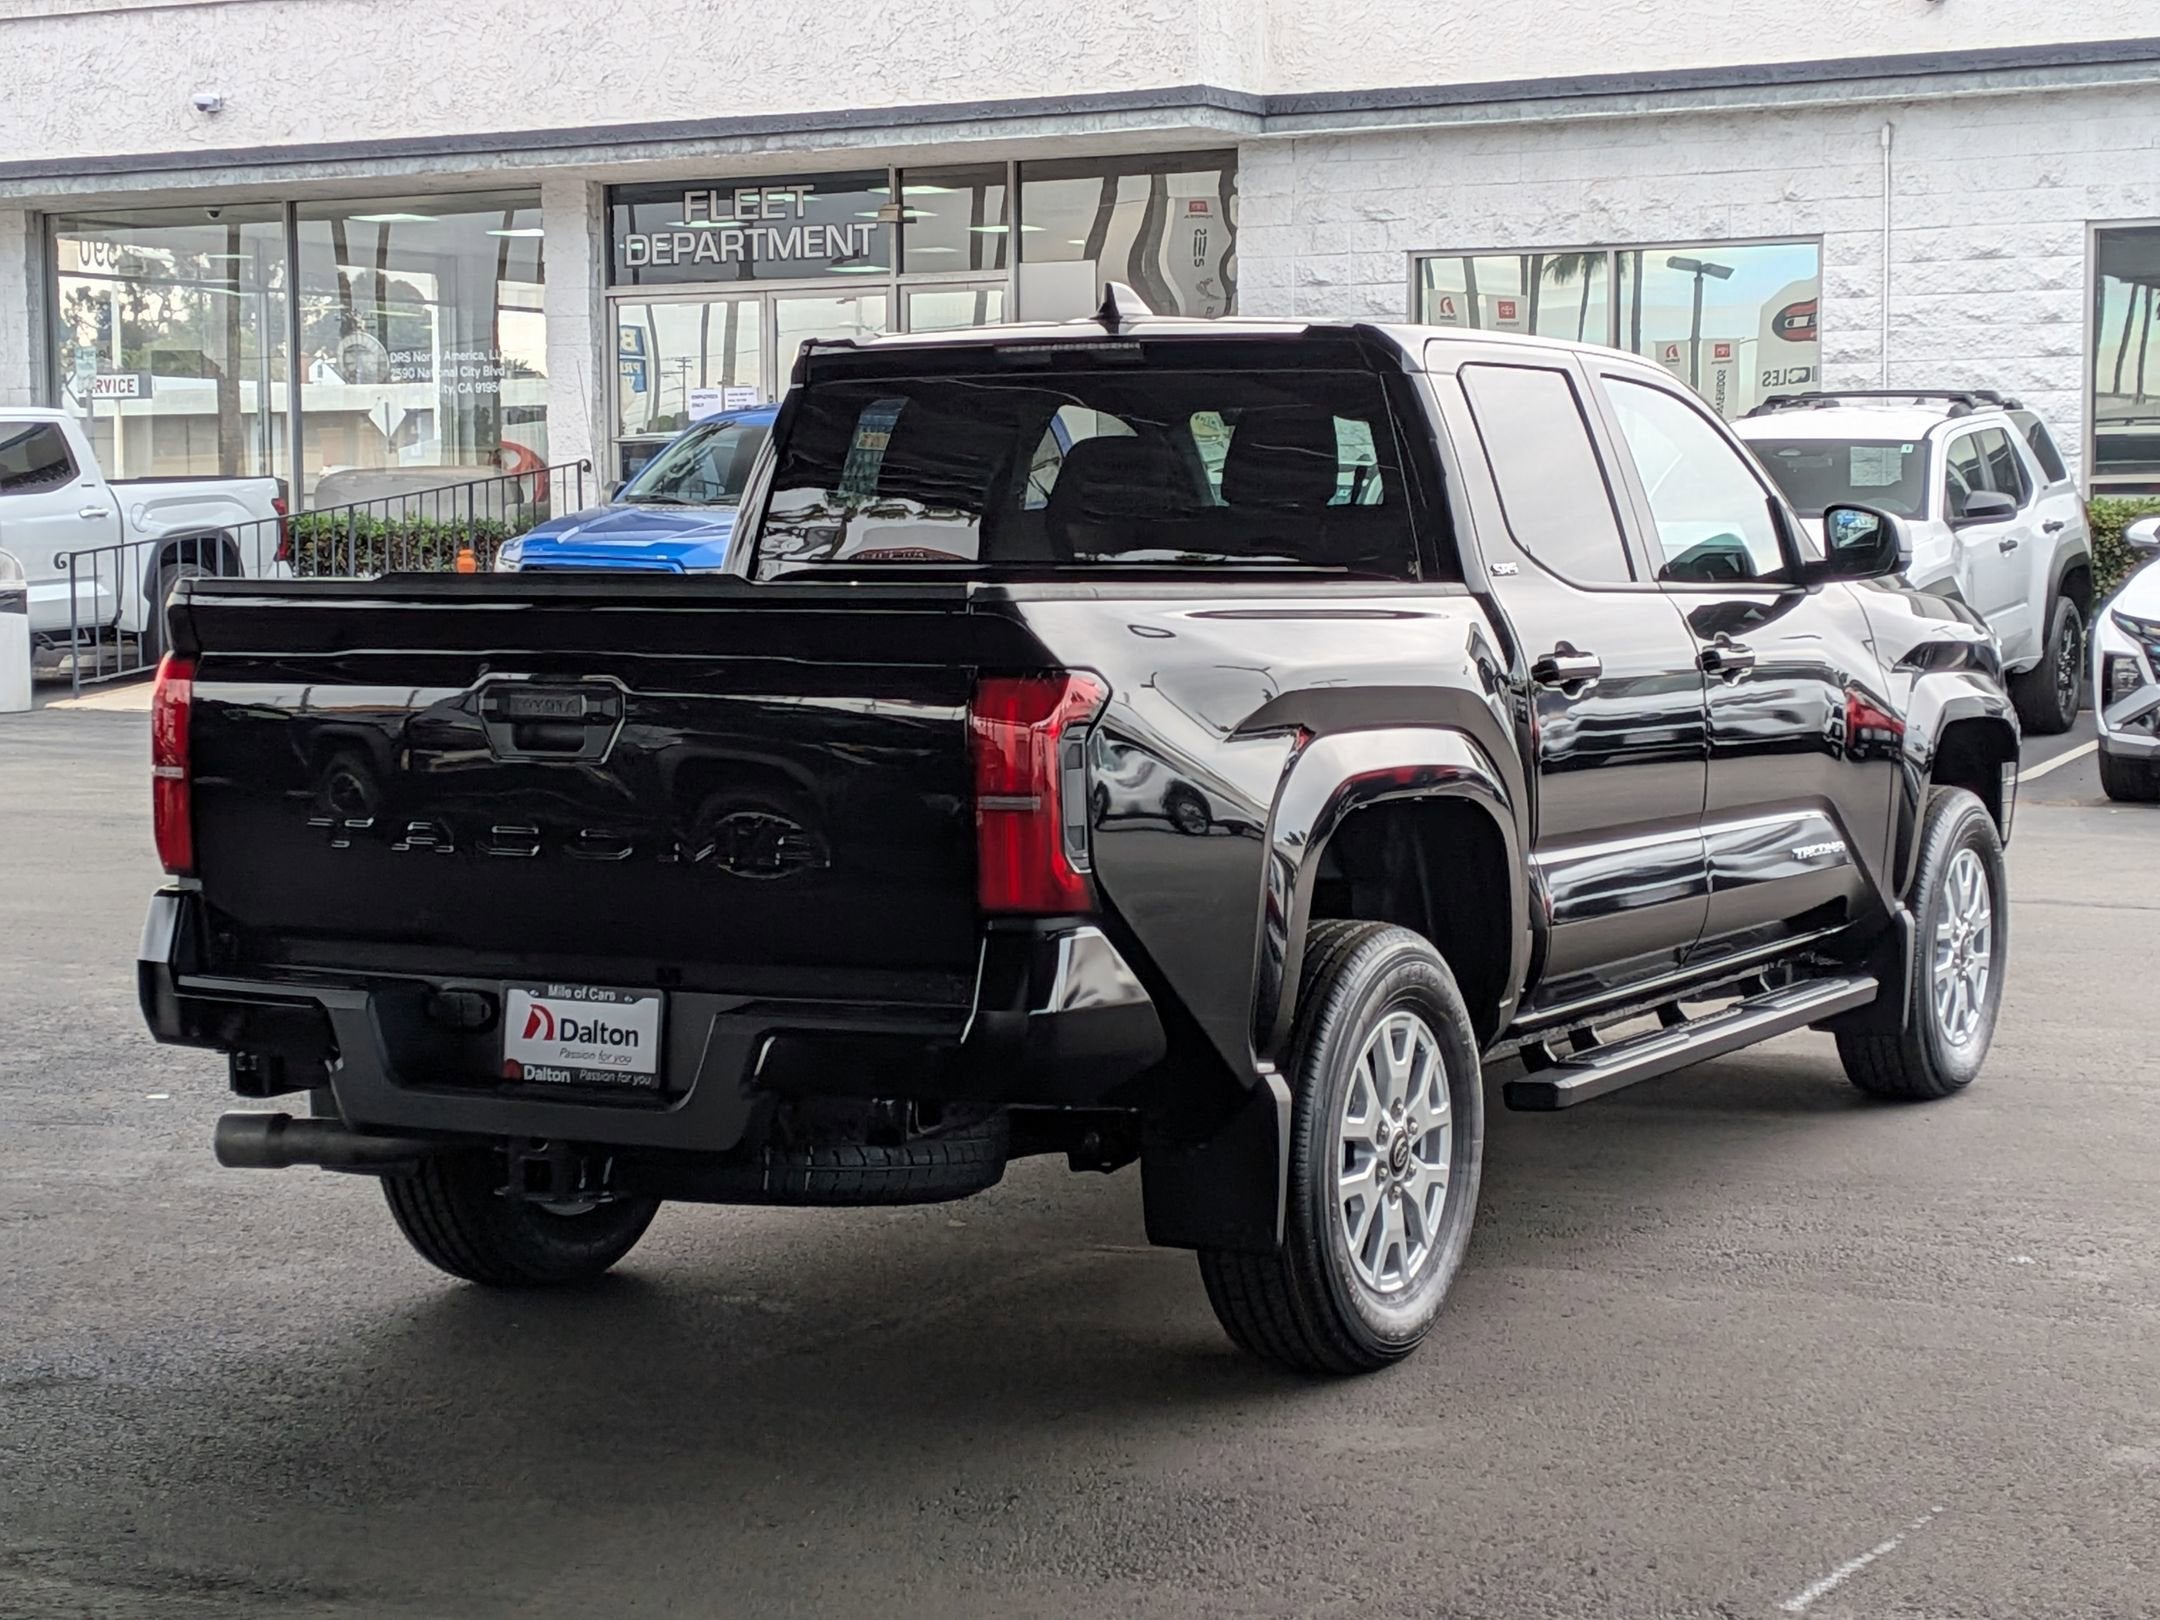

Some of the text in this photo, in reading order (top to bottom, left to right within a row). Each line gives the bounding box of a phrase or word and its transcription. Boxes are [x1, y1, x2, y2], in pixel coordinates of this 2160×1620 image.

[683, 183, 815, 224] FLEET
[625, 222, 878, 267] DEPARTMENT
[390, 351, 411, 364] DRS
[444, 349, 487, 362] America,
[390, 366, 415, 380] 2590
[460, 365, 480, 379] City
[483, 364, 506, 377] Blvd
[78, 378, 136, 394] RVICE
[458, 382, 473, 394] CA
[475, 381, 501, 393] 9195
[548, 983, 617, 1002] Mile of Cars
[560, 1017, 639, 1048] Dalton
[559, 1047, 633, 1065] Passion for you
[524, 1065, 652, 1087] Dalton Passion for you
